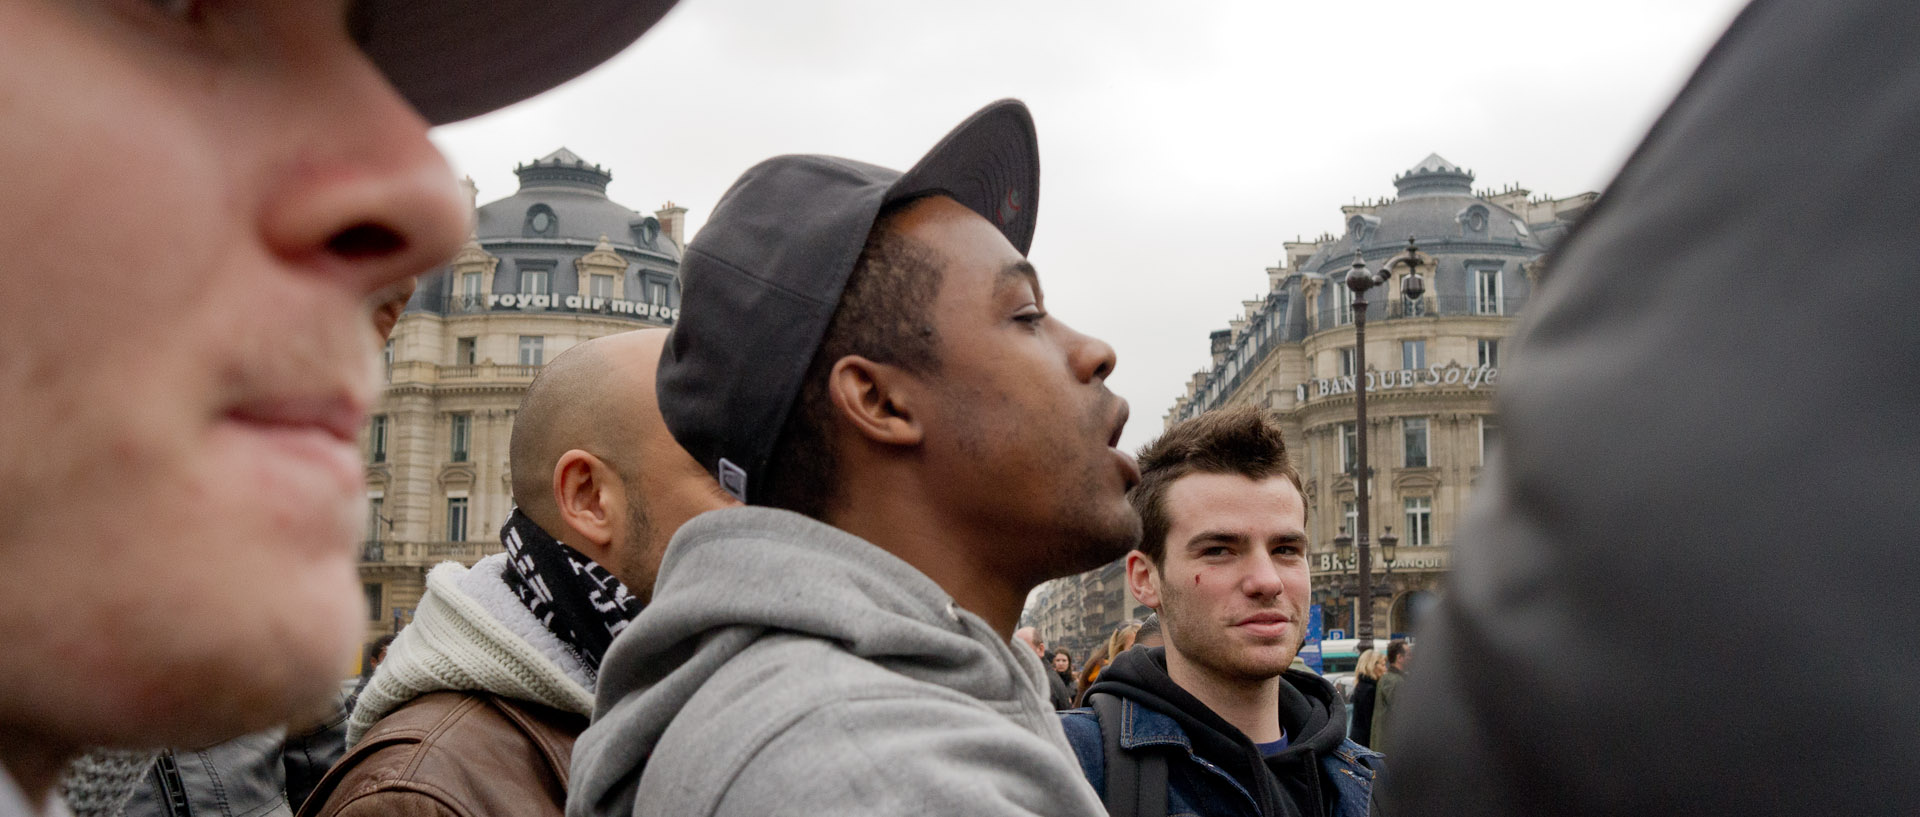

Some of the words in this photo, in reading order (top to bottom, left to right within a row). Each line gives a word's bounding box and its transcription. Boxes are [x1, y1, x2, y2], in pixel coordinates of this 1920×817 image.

[487, 292, 560, 309] royal
[565, 294, 604, 310] air
[611, 299, 680, 321] maroc
[1318, 370, 1414, 396] BANQUE
[1320, 553, 1373, 571] BRE
[1333, 632, 1341, 640] P
